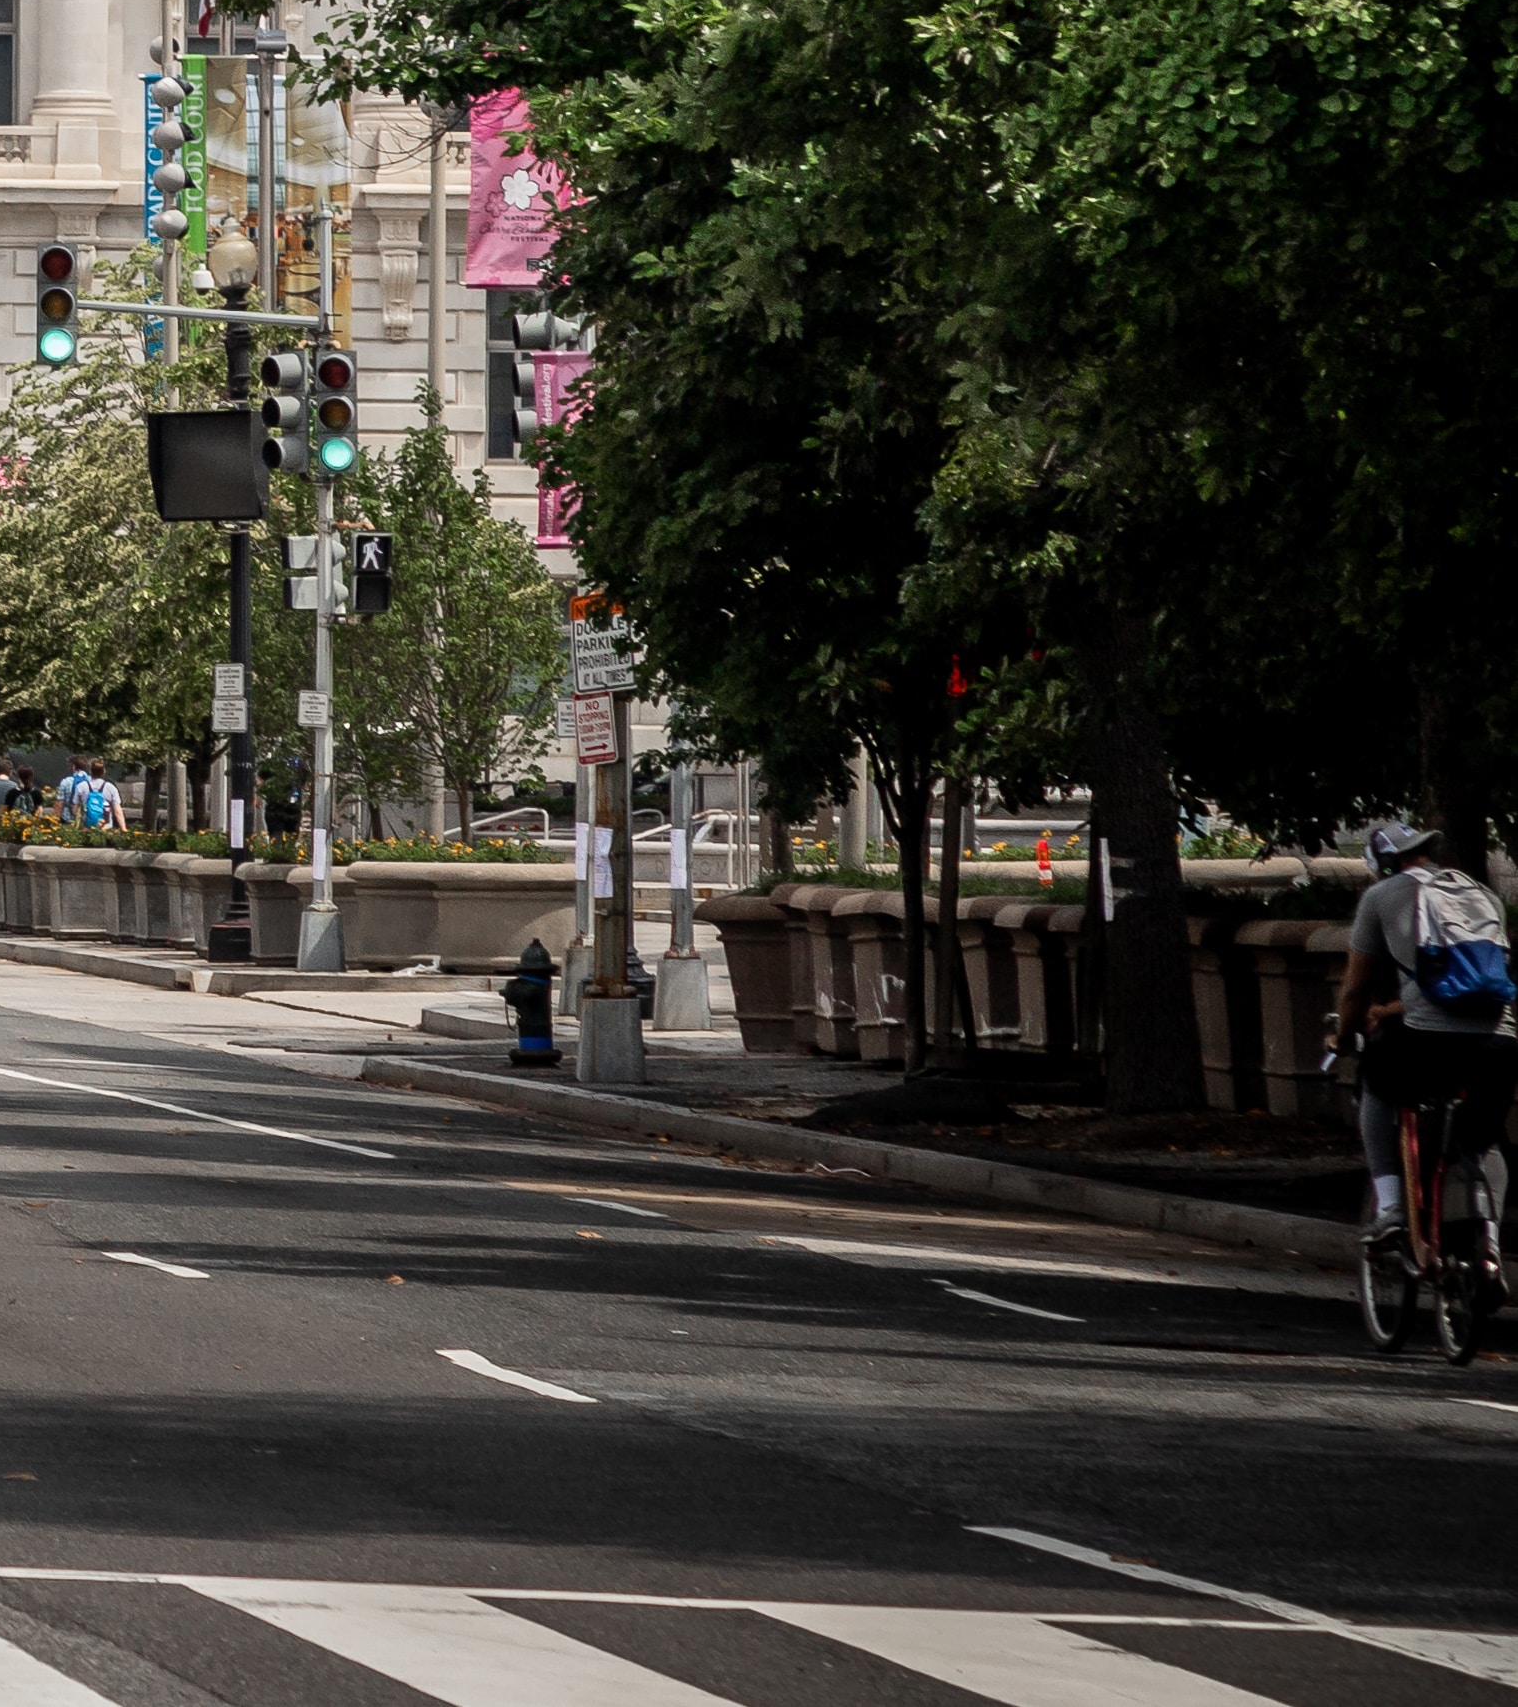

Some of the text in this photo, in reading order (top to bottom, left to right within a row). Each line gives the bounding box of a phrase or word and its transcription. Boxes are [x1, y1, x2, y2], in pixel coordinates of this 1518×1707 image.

[186, 73, 204, 213] FOOD COURT
[576, 616, 625, 637] DOLE
[578, 651, 630, 670] PROHIBITED
[584, 700, 600, 711] NO
